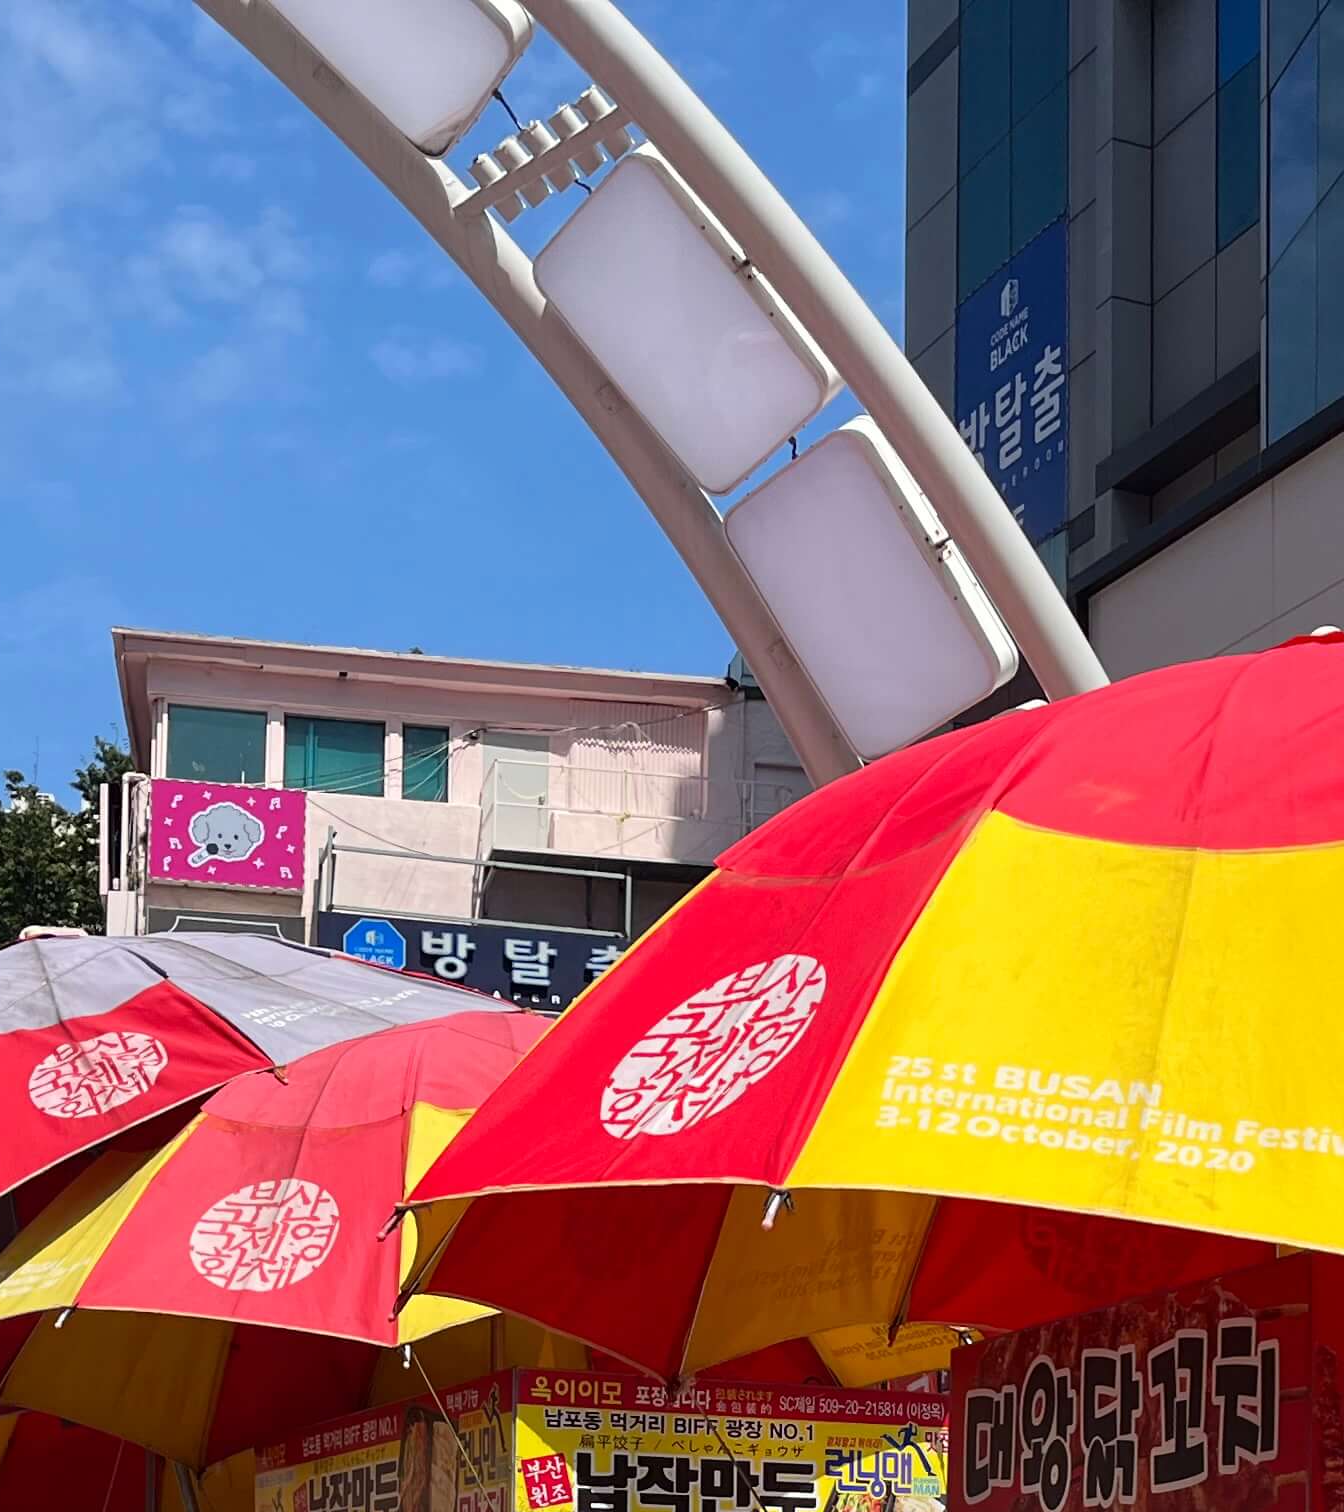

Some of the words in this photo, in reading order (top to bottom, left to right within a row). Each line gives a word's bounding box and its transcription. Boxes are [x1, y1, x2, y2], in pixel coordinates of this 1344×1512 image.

[990, 323, 1029, 371] BLACK
[886, 1055, 934, 1079] 25
[942, 1061, 978, 1086] st
[994, 1065, 1164, 1108] BUSAN
[881, 1077, 1130, 1131] International
[1141, 1108, 1222, 1142] Film
[875, 1104, 960, 1135] 3-12
[966, 1114, 1142, 1162] October,
[1154, 1140, 1254, 1173] 2020
[530, 1375, 623, 1406] 옥이이모
[544, 1408, 603, 1431] 남포동
[610, 1413, 666, 1435] 먹거리
[673, 1417, 718, 1434] BIFF
[725, 1417, 763, 1440] 광장
[769, 1422, 815, 1442] NO.1
[524, 1455, 565, 1480] 부산
[824, 1448, 914, 1498] 런닝맨
[529, 1483, 570, 1508] 원조
